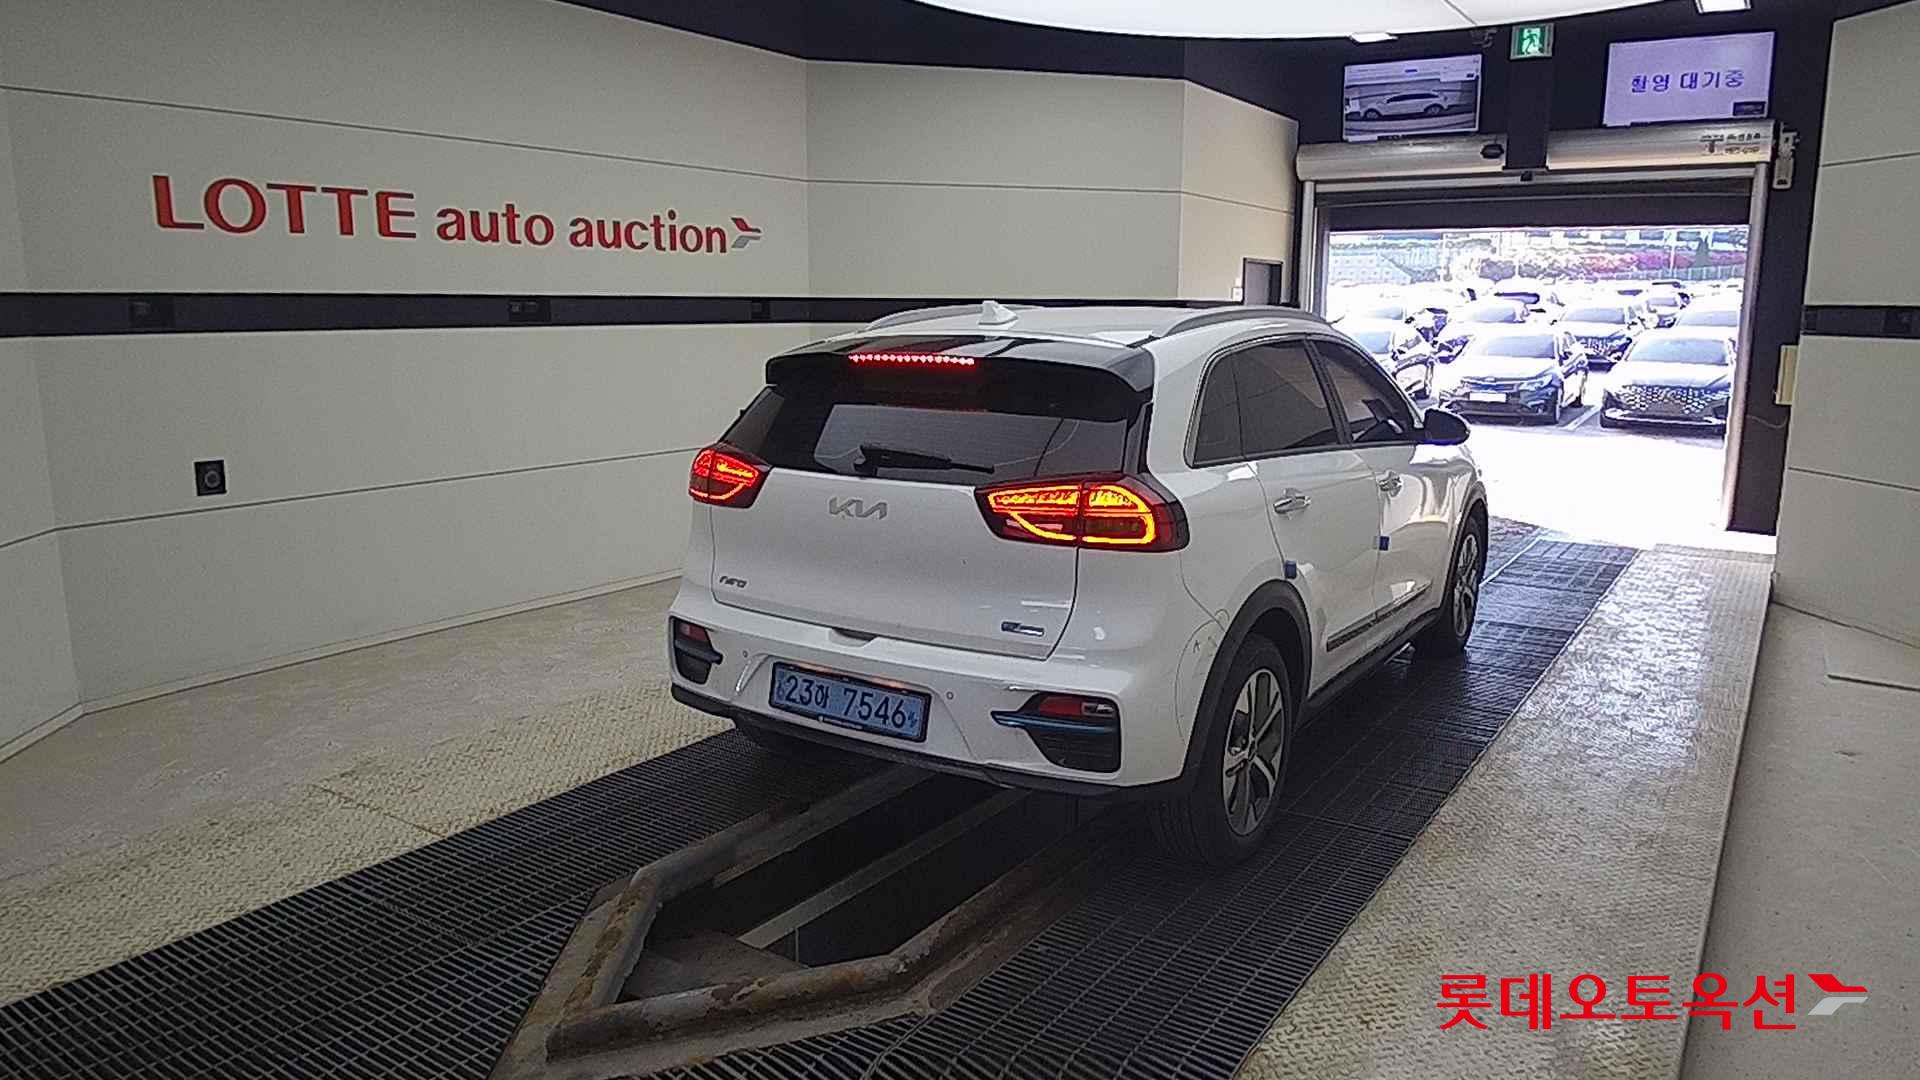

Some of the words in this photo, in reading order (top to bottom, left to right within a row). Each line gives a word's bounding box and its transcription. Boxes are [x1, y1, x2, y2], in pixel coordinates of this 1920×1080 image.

[1631, 75, 1670, 93] 촬영
[1679, 69, 1744, 90] 대기중
[152, 174, 417, 239] LOTTE
[436, 203, 554, 246] auto
[569, 209, 727, 254] auction
[828, 497, 887, 520] KIA
[842, 688, 907, 728] 7546
